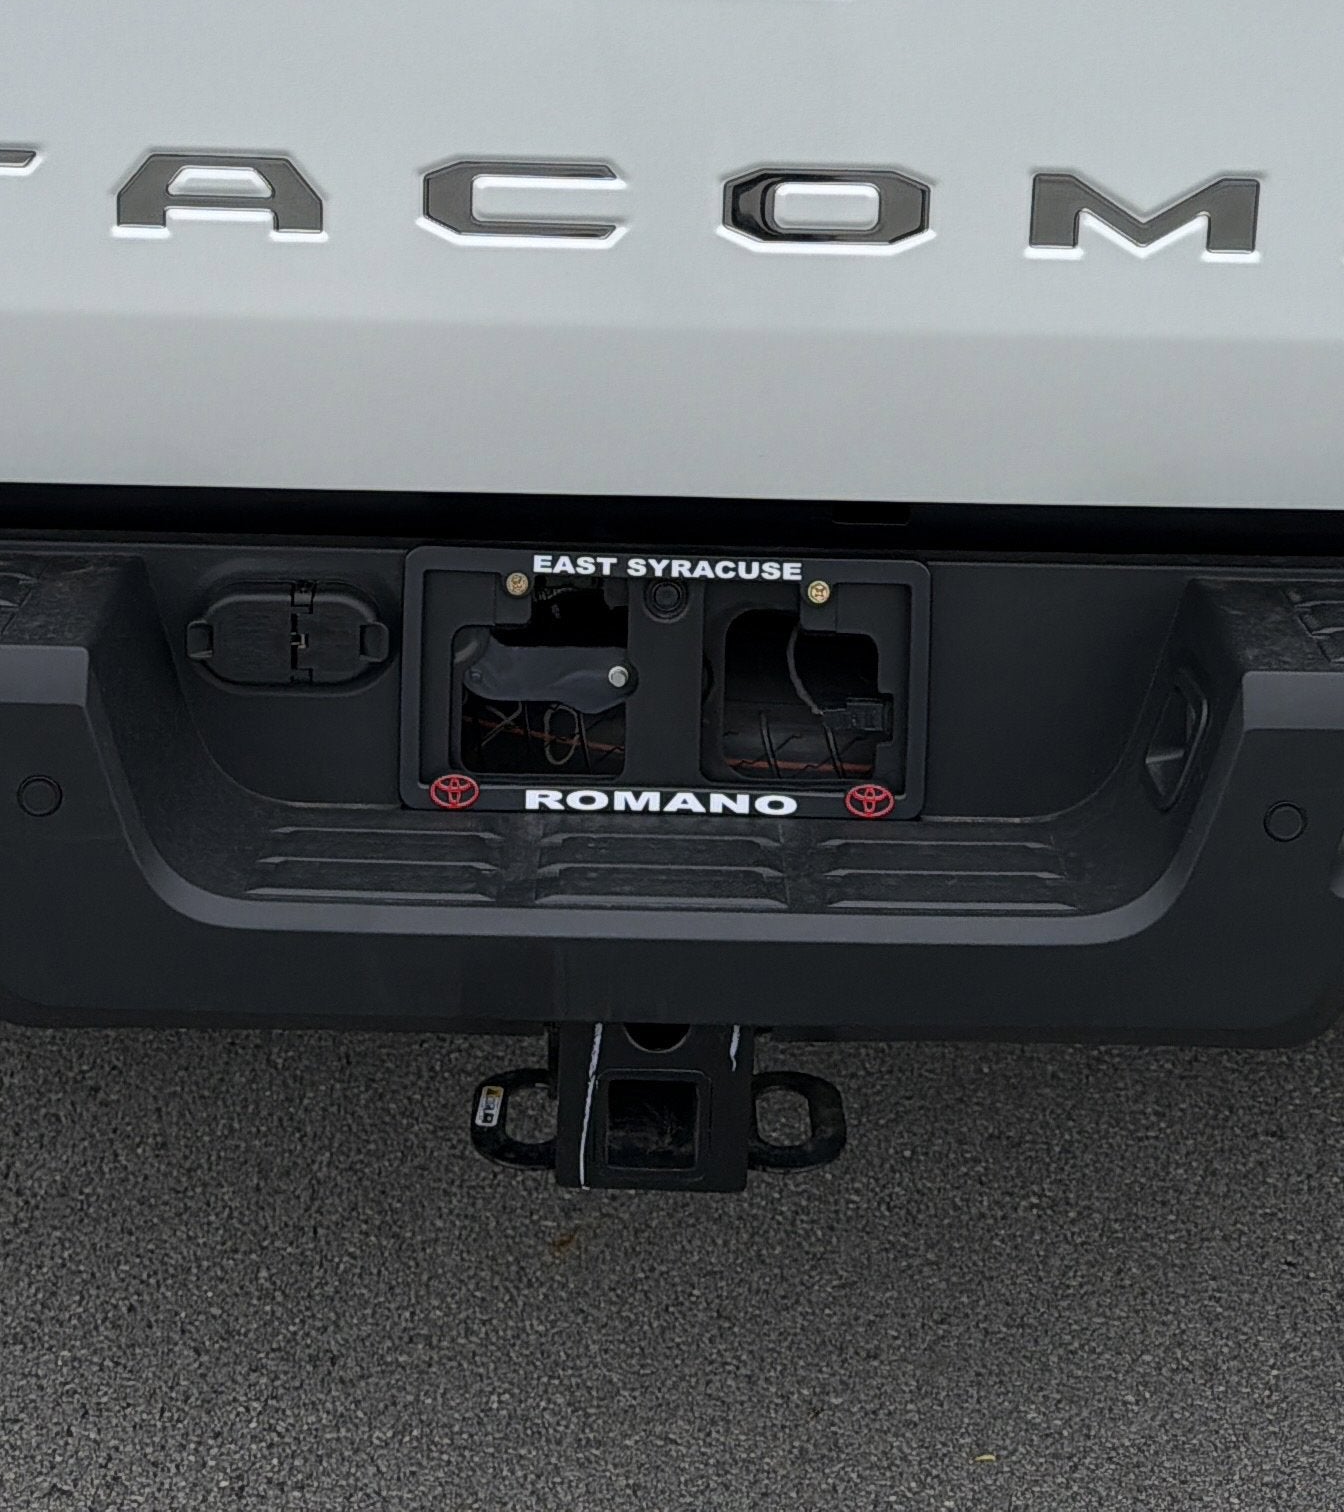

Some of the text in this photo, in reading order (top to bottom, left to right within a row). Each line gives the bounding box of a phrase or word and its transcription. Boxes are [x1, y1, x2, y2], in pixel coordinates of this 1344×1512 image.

[533, 554, 802, 581] EAST SYRACUSE
[525, 789, 798, 816] ROMANO
